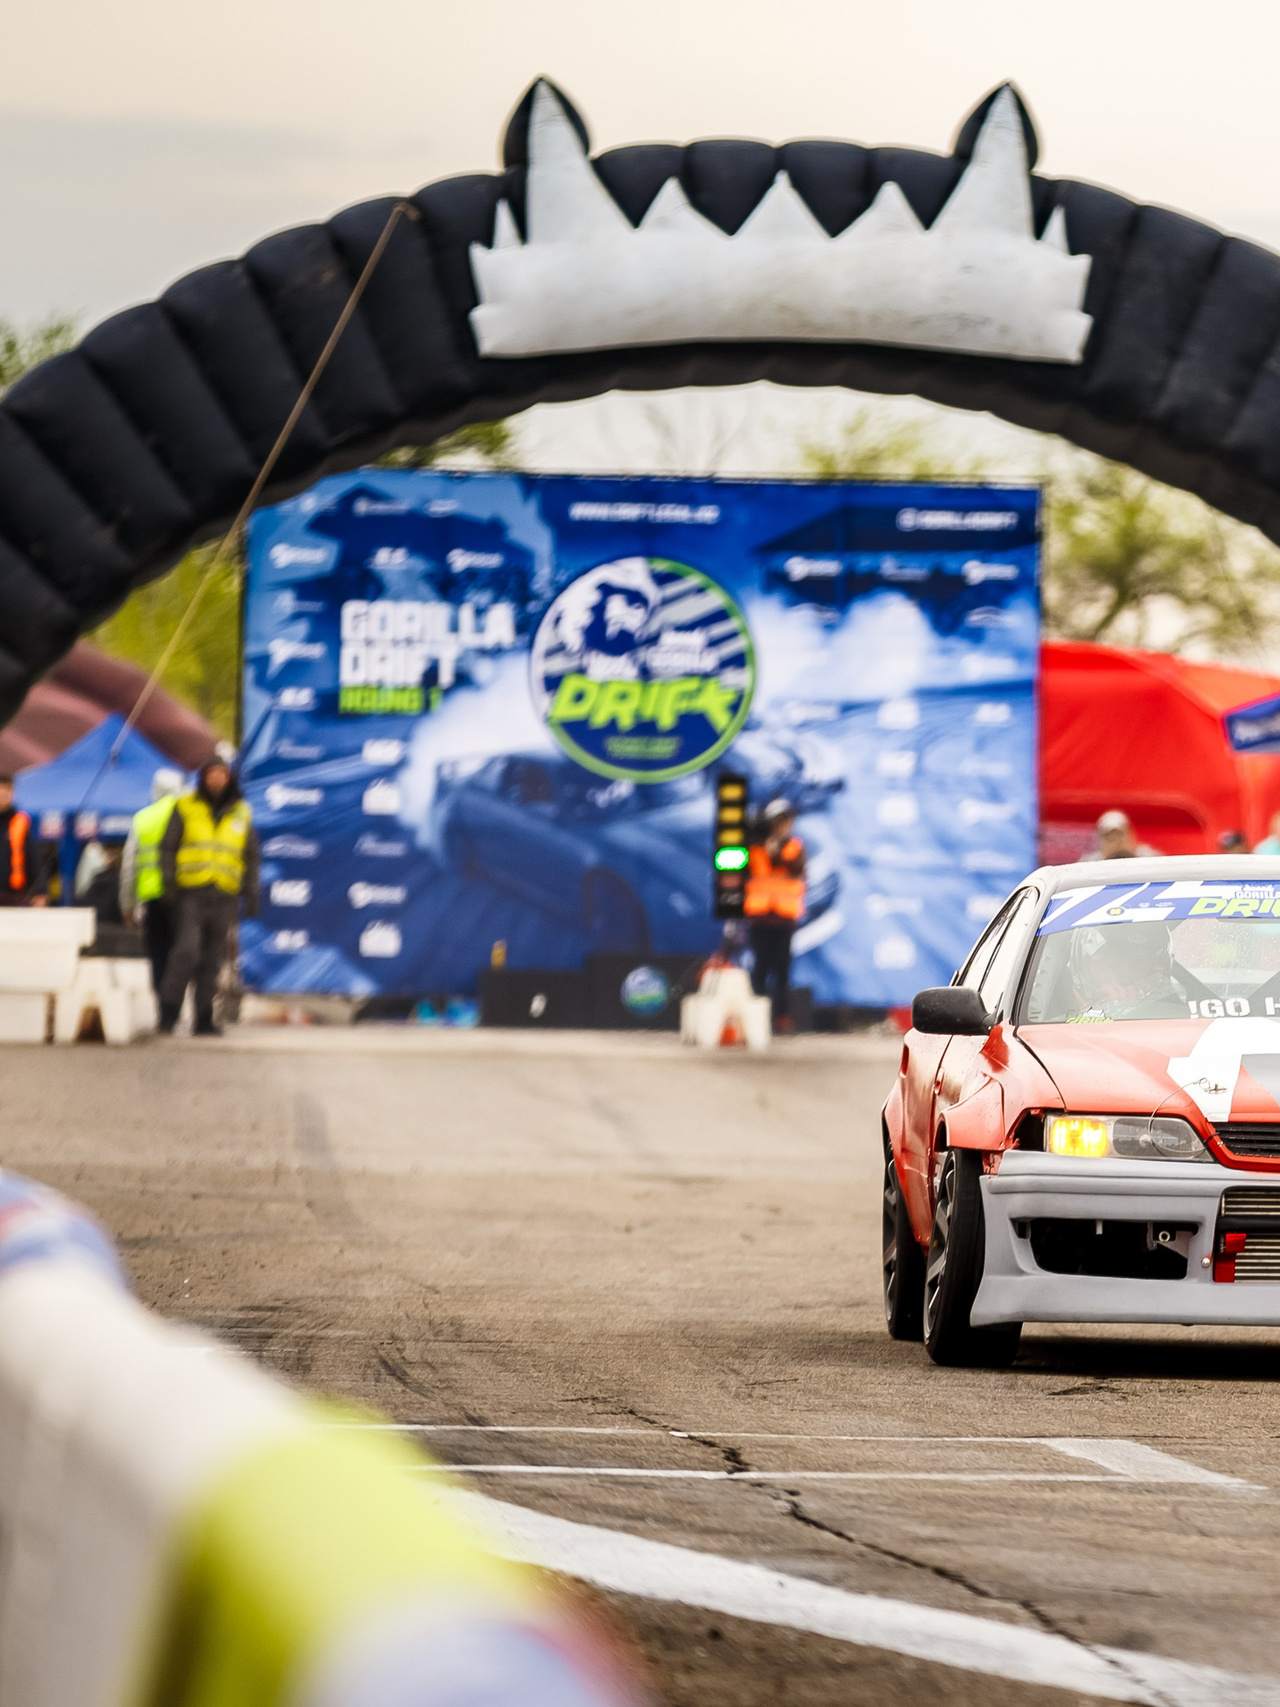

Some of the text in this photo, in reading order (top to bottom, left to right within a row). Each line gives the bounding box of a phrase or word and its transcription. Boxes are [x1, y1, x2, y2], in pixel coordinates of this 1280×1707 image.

[341, 600, 516, 646] GORILLA
[340, 641, 458, 689] DRIFT
[1187, 997, 1251, 1019] !GO
